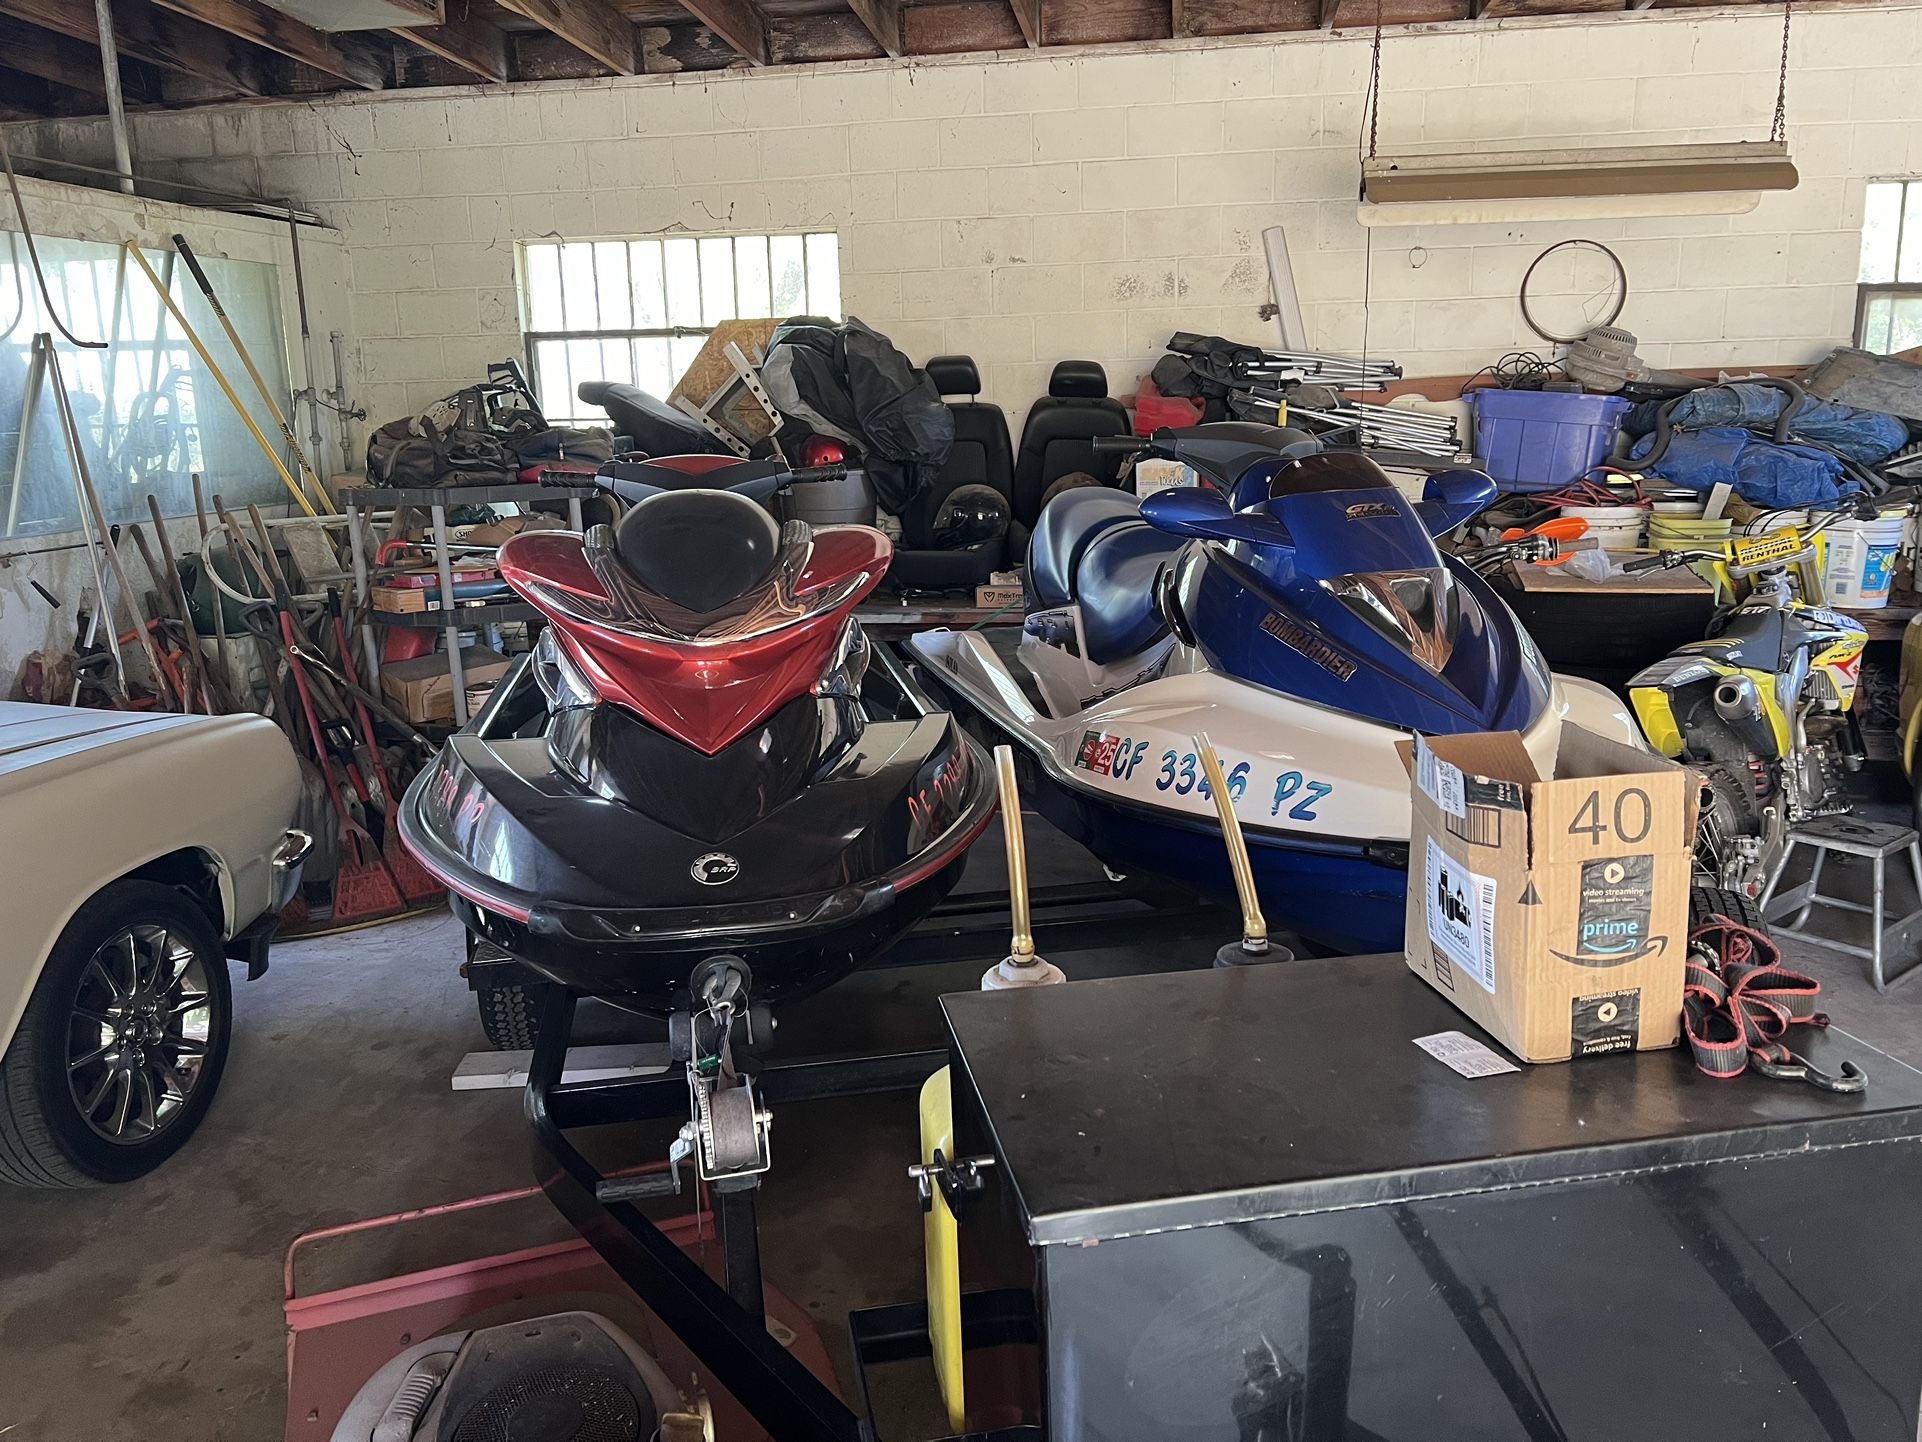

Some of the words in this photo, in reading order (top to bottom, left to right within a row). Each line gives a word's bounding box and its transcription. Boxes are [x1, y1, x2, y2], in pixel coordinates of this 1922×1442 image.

[1742, 544, 1796, 562] RENTHAL
[1259, 612, 1356, 680] BOMBARDIER
[1097, 742, 1116, 766] 25
[1112, 737, 1150, 781] CF
[1271, 771, 1333, 821] PZ
[1567, 787, 1653, 846] 40
[1582, 889, 1604, 897] video
[1605, 887, 1645, 897] streaming
[1583, 919, 1638, 941] prime
[1582, 1043, 1614, 1054] delivery
[1614, 1040, 1631, 1049] free
